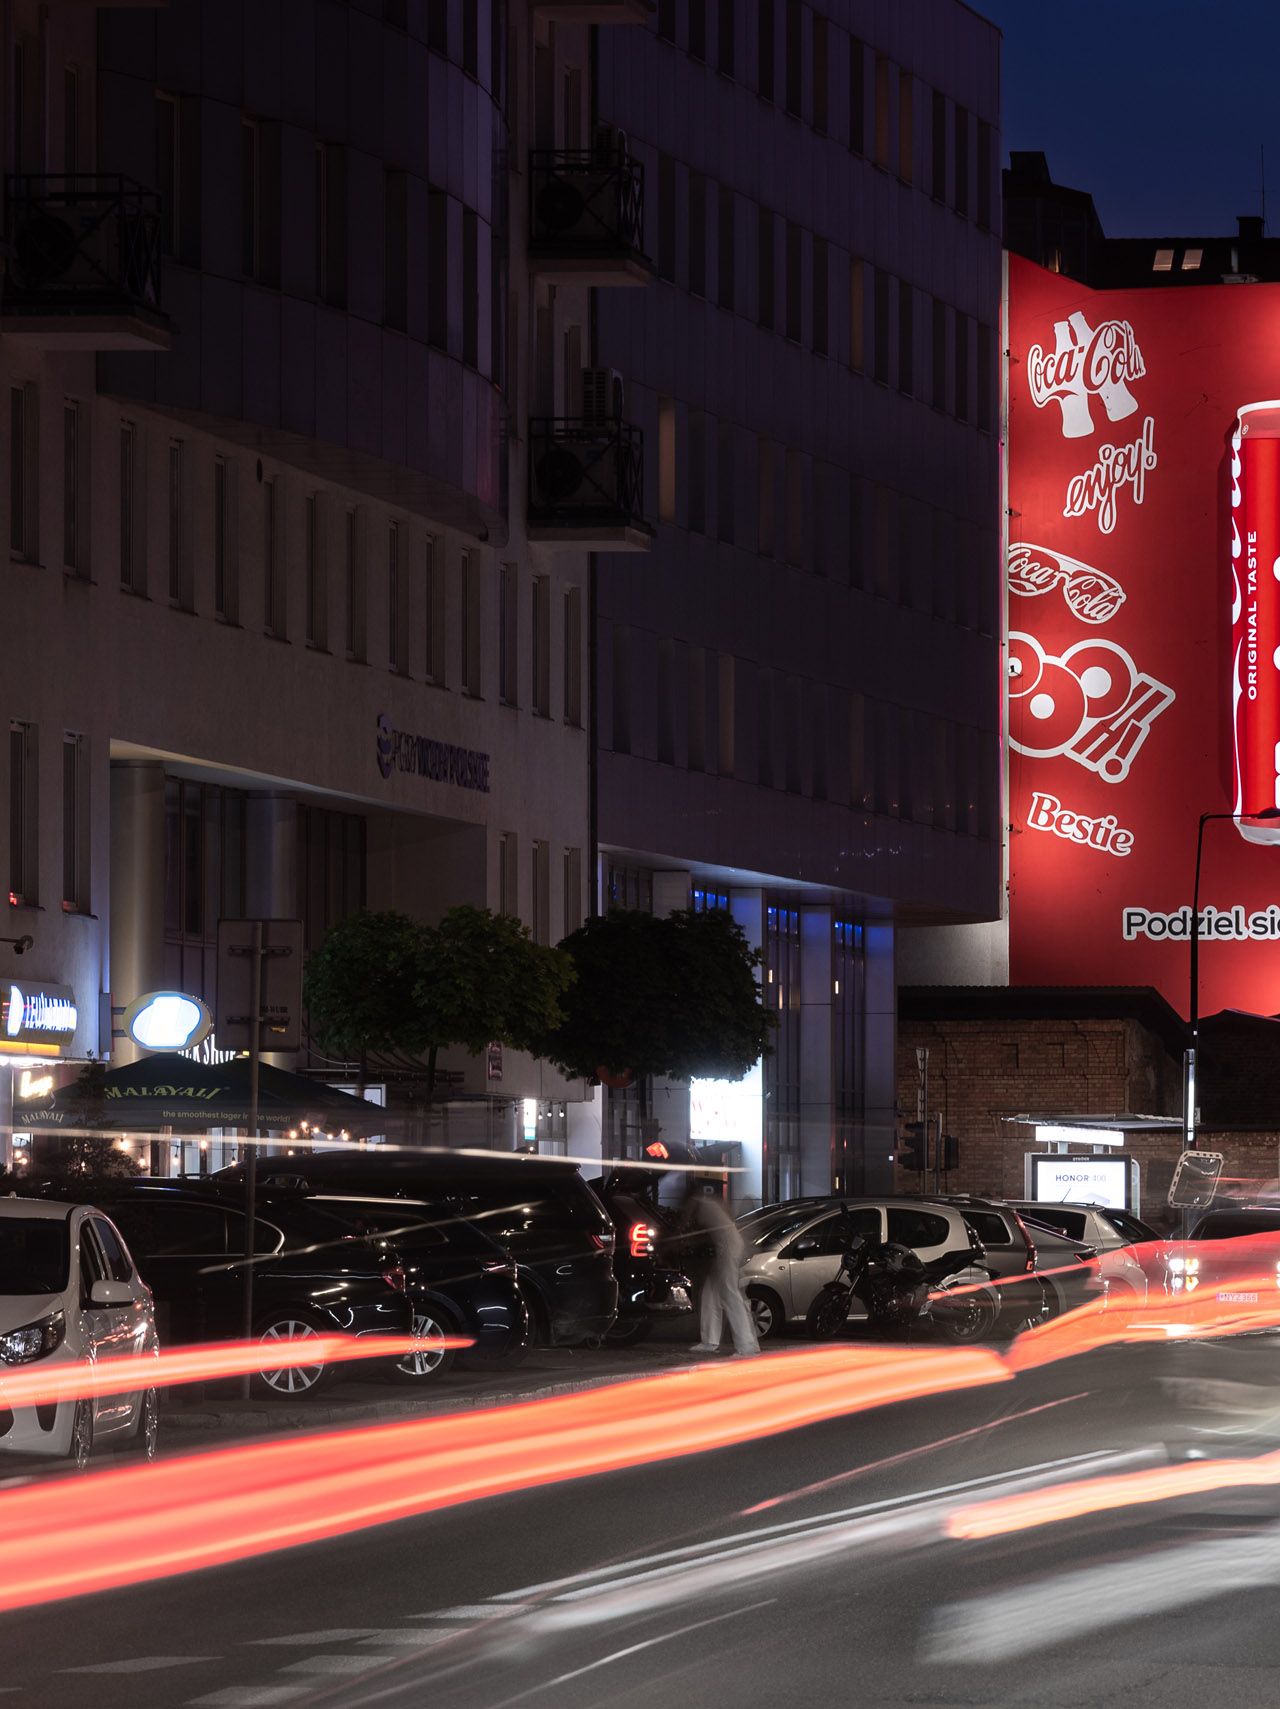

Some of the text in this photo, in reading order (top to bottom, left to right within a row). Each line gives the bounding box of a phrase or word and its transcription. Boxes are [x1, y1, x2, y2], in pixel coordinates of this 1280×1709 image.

[1028, 319, 1146, 408] Coca-Cola
[1063, 416, 1157, 534] enjoy!
[1248, 531, 1257, 701] ORIGINAL TASTE
[1027, 792, 1134, 855] Bestie
[1125, 909, 1244, 937] Podziel
[104, 1084, 222, 1101] MALAYALI
[21, 1109, 65, 1125] MALAYALI
[162, 1110, 176, 1120] the
[177, 1111, 219, 1121] smoothest
[220, 1111, 241, 1123] lager
[1055, 1174, 1089, 1183] HONOR
